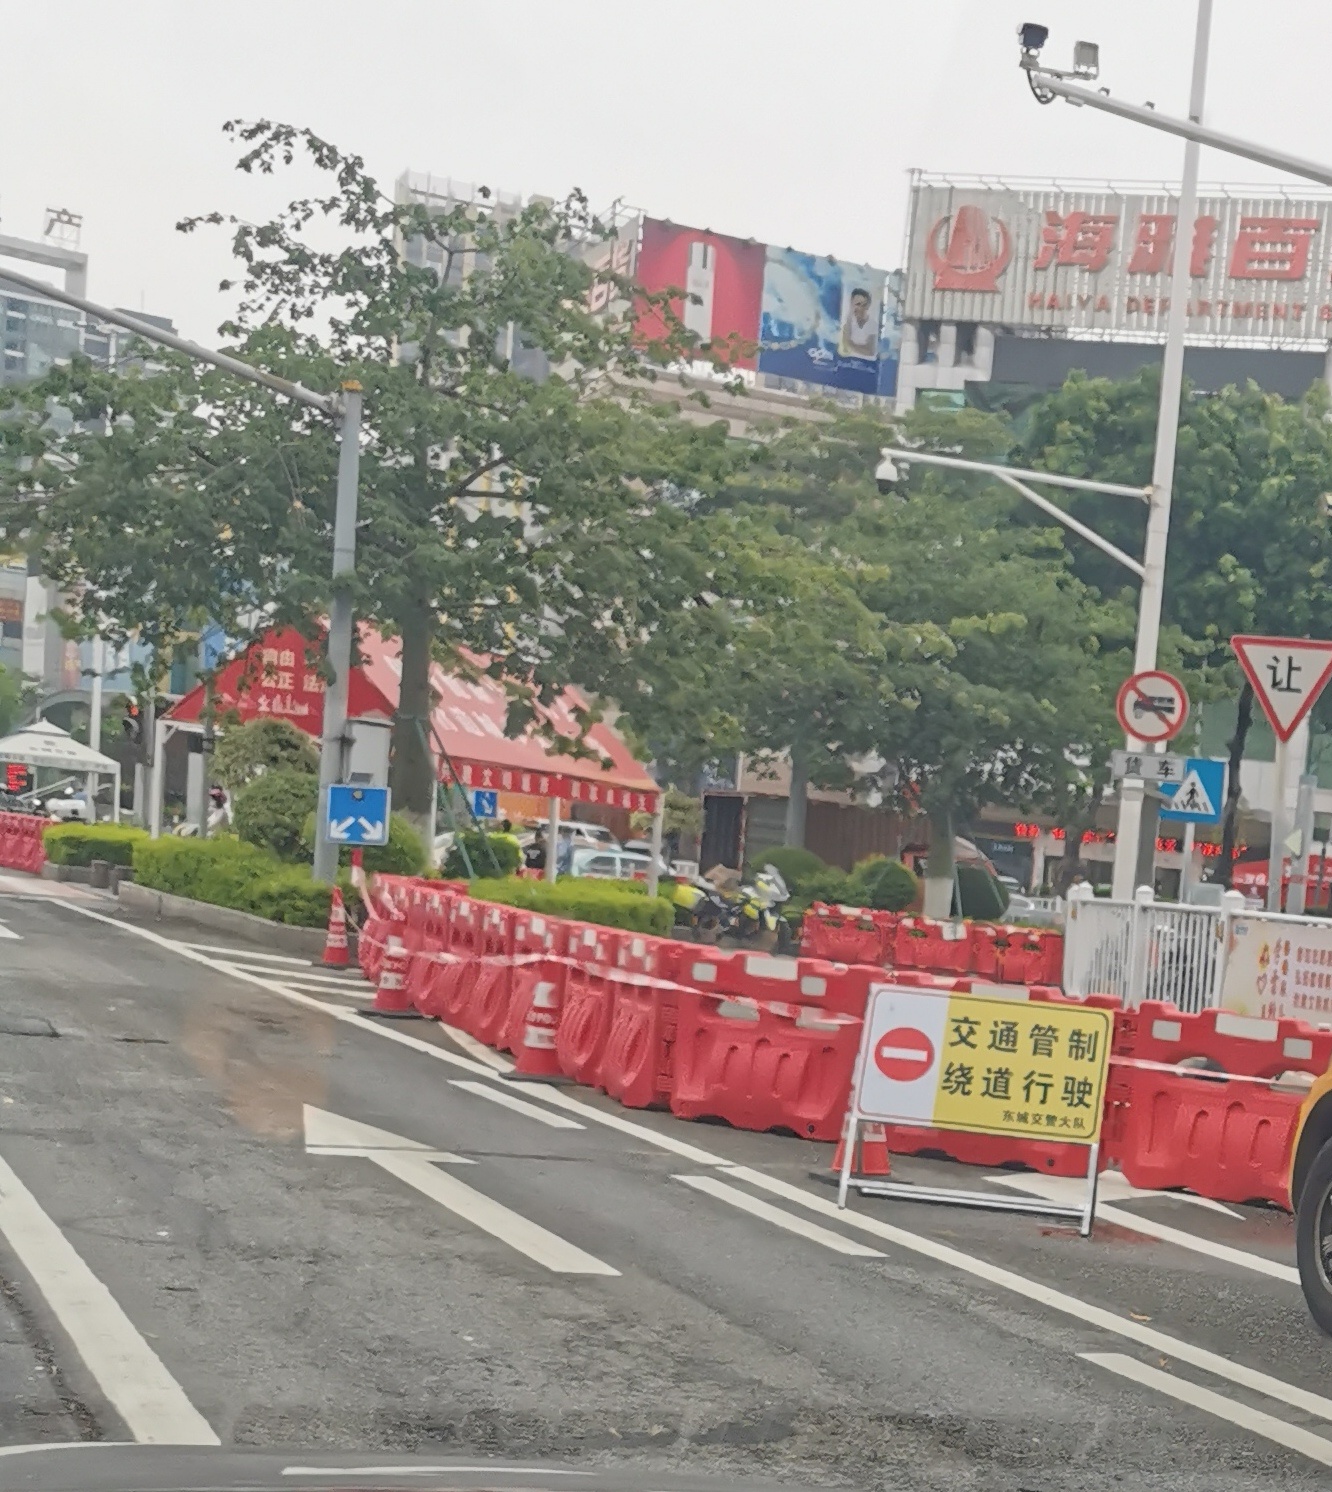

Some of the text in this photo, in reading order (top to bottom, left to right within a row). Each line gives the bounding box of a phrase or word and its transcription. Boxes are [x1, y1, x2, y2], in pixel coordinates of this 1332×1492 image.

[1027, 293, 1111, 313] HAIYA
[1266, 655, 1302, 693] 让
[1124, 756, 1177, 778] 货车
[949, 1016, 1099, 1063] 交通管制
[941, 1062, 1093, 1109] 绕道行驶
[1002, 1109, 1086, 1131] 东城交警大队
